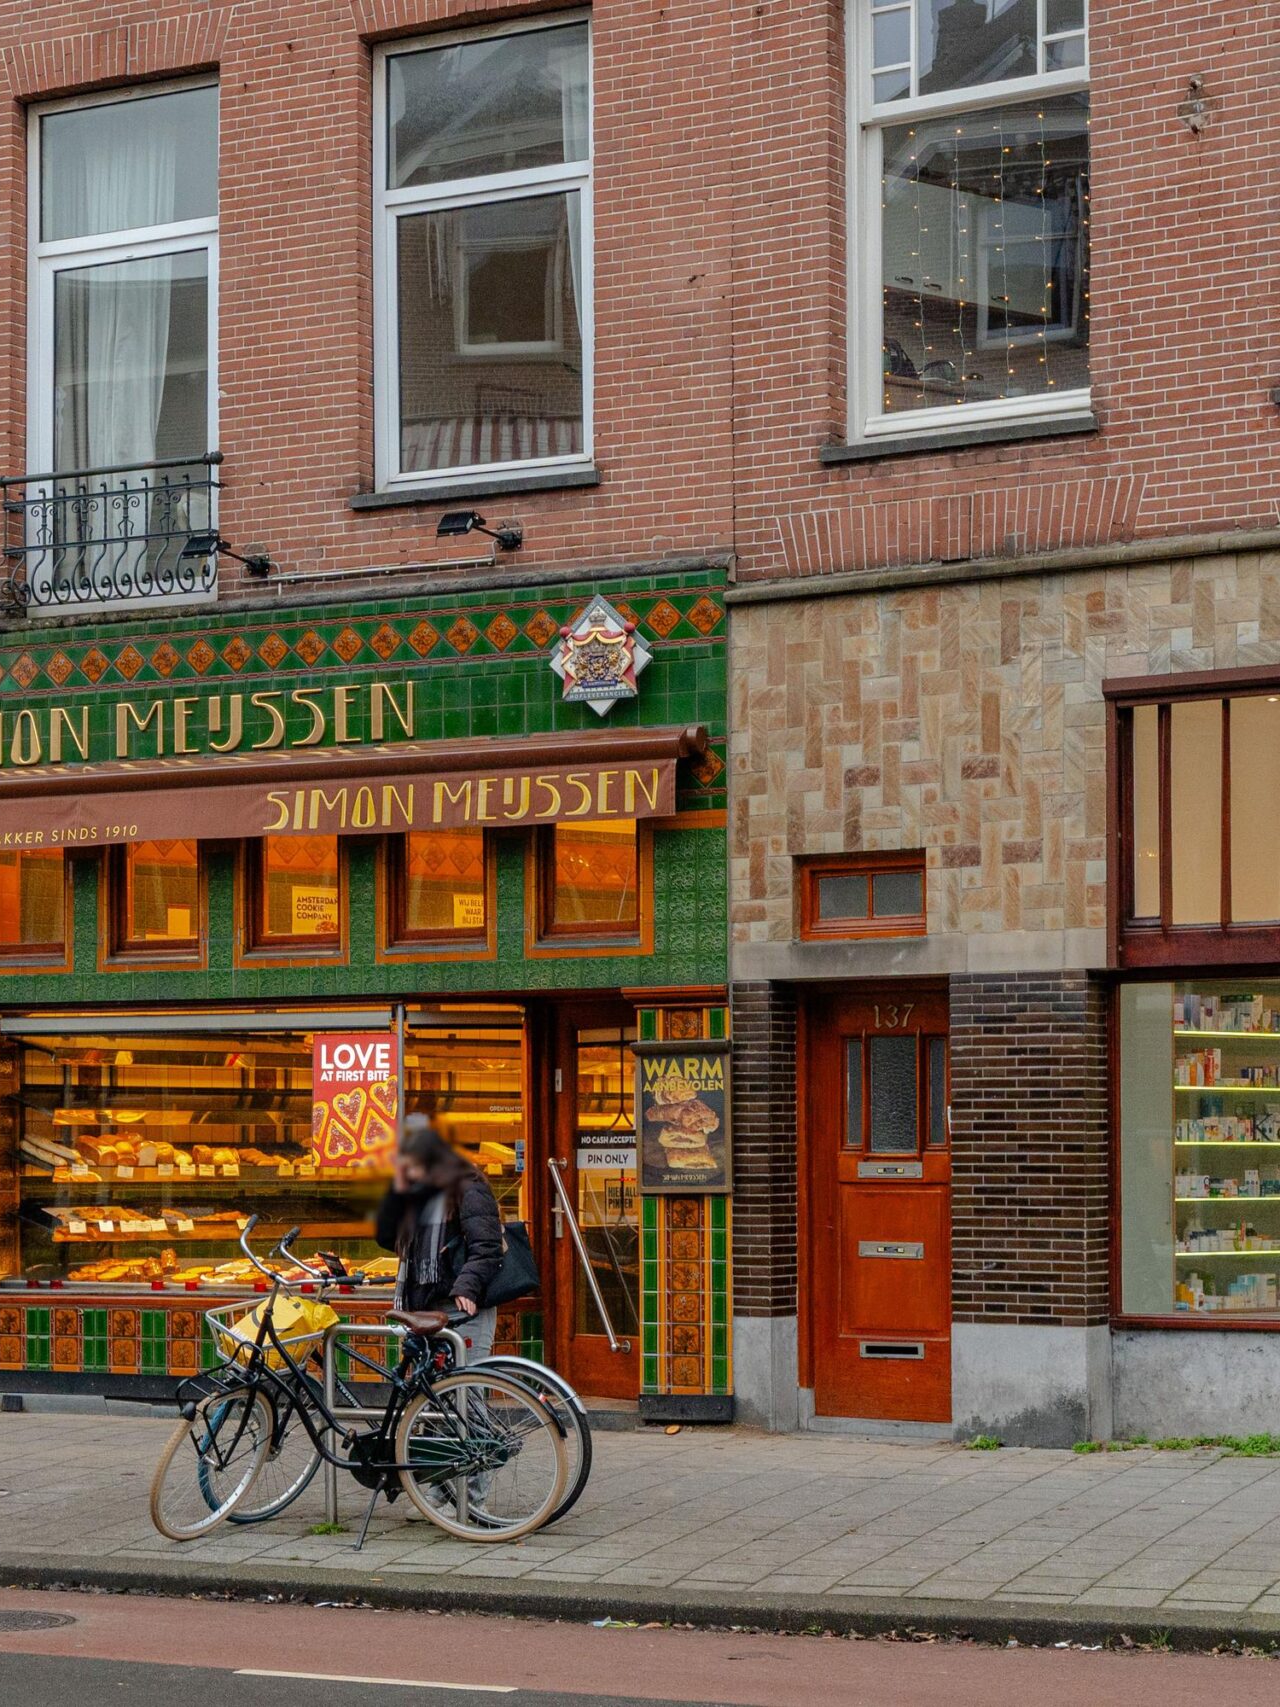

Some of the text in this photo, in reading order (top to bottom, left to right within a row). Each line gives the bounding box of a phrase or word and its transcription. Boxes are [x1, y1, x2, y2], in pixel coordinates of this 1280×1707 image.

[263, 784, 414, 830] SIMON
[51, 826, 98, 842] SINDS
[105, 824, 138, 838] 1910
[297, 904, 324, 912] COOKIE
[297, 912, 332, 921] COMPANY
[874, 1003, 914, 1029] 137
[321, 1043, 391, 1070] LOVE
[643, 1057, 724, 1081] WARM
[320, 1070, 390, 1082] AT FIRST BITE
[643, 1080, 724, 1092] AANBEVOLEN
[581, 1136, 591, 1144] NO
[592, 1136, 608, 1144] CASH
[587, 1154, 629, 1164] PIN ONLY
